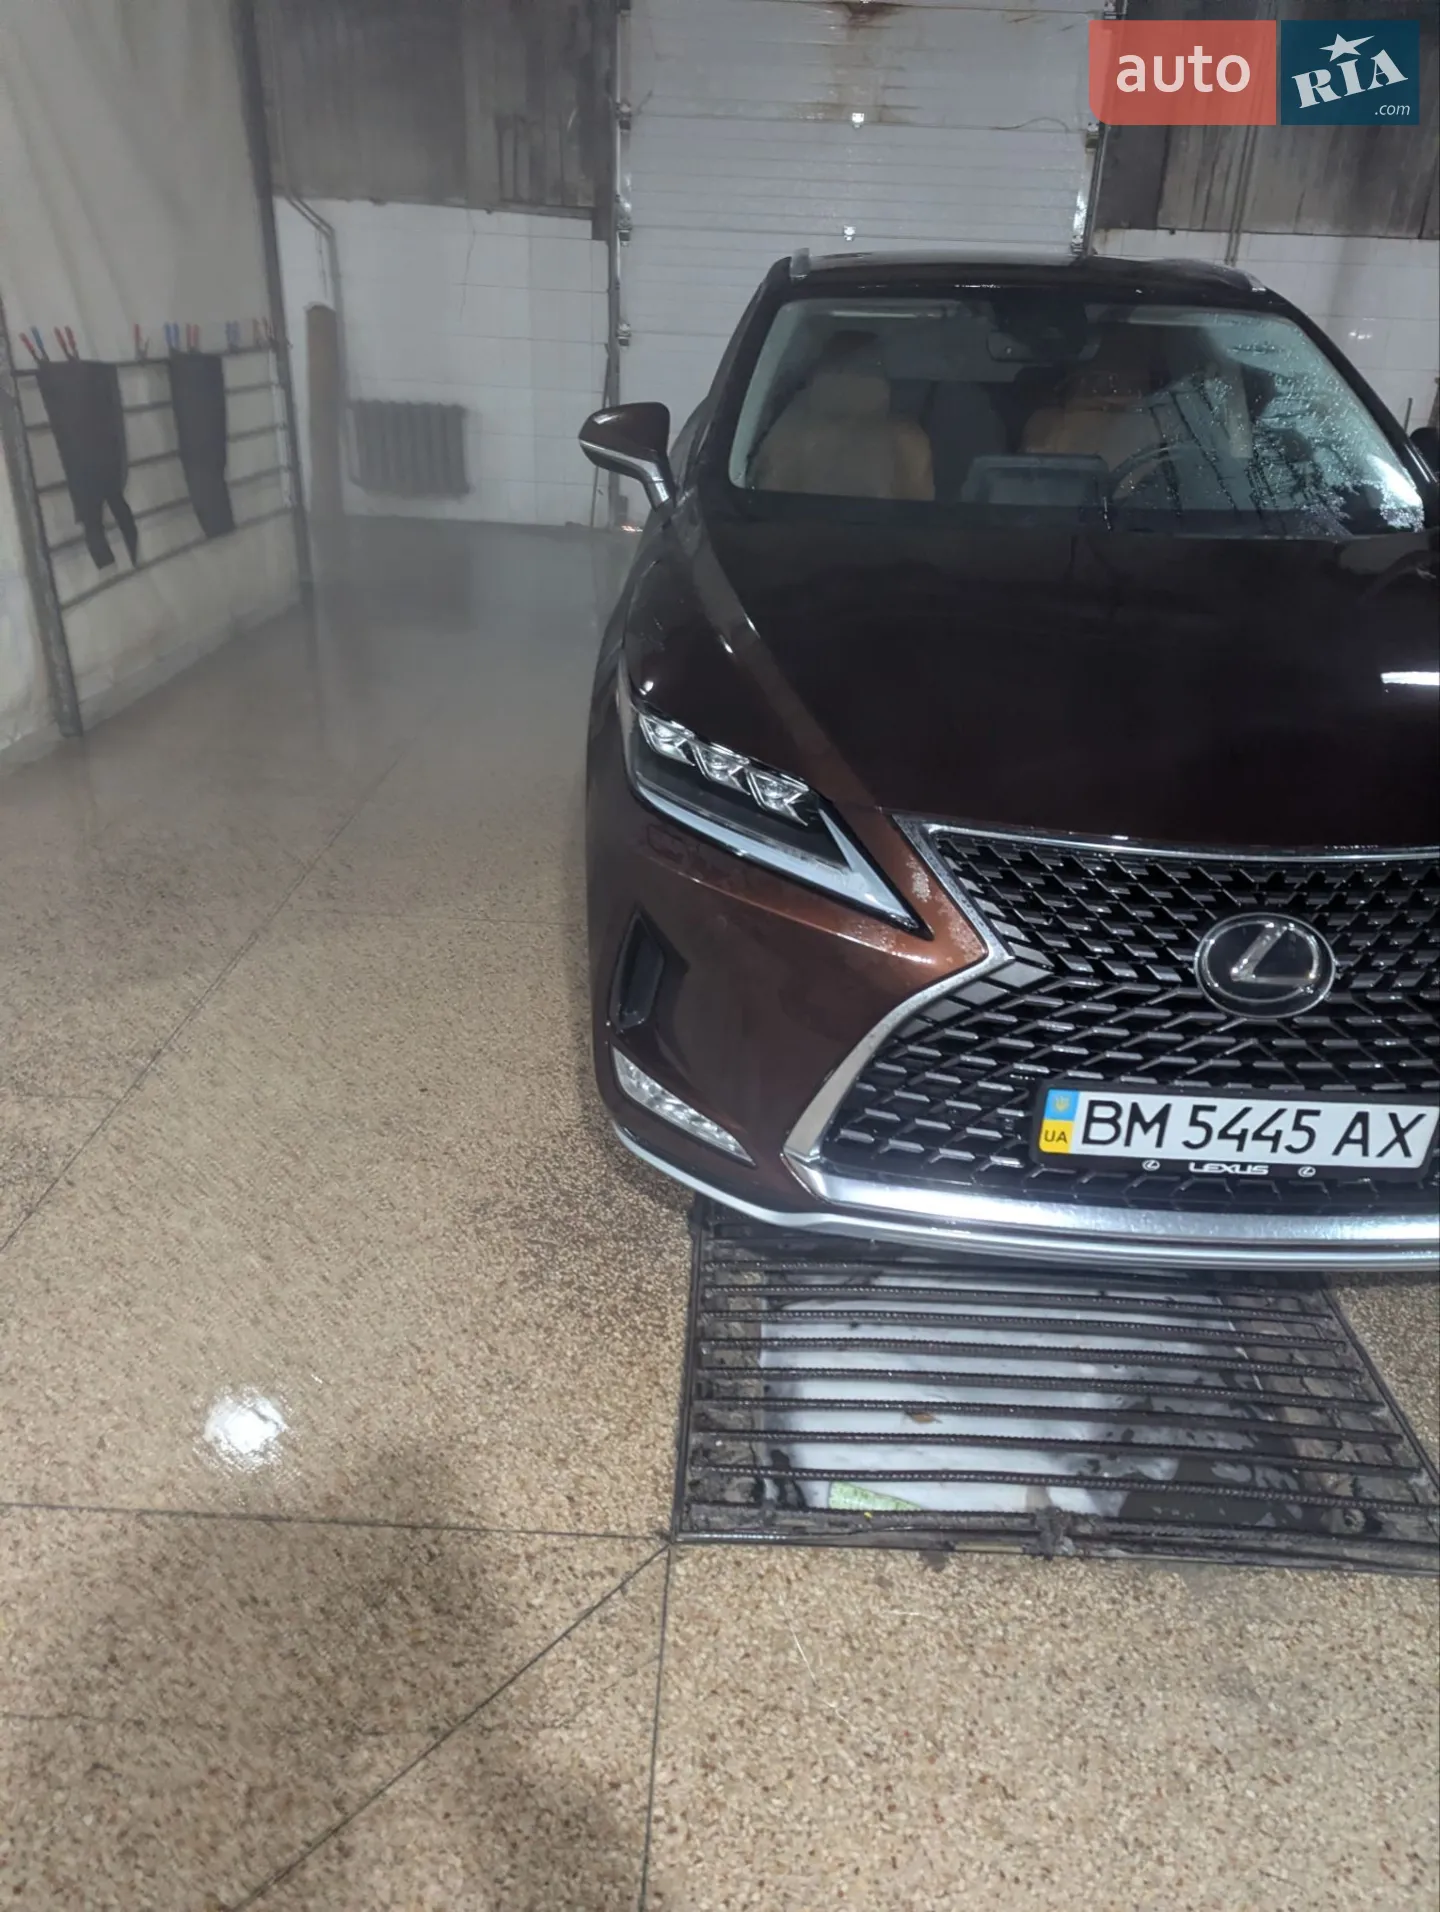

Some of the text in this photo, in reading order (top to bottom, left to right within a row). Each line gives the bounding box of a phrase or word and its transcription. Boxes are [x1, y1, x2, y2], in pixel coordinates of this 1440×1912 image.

[1081, 1099, 1427, 1158] BM 5445 AX
[1044, 1129, 1068, 1144] UA
[1188, 1162, 1269, 1175] LEXUS
